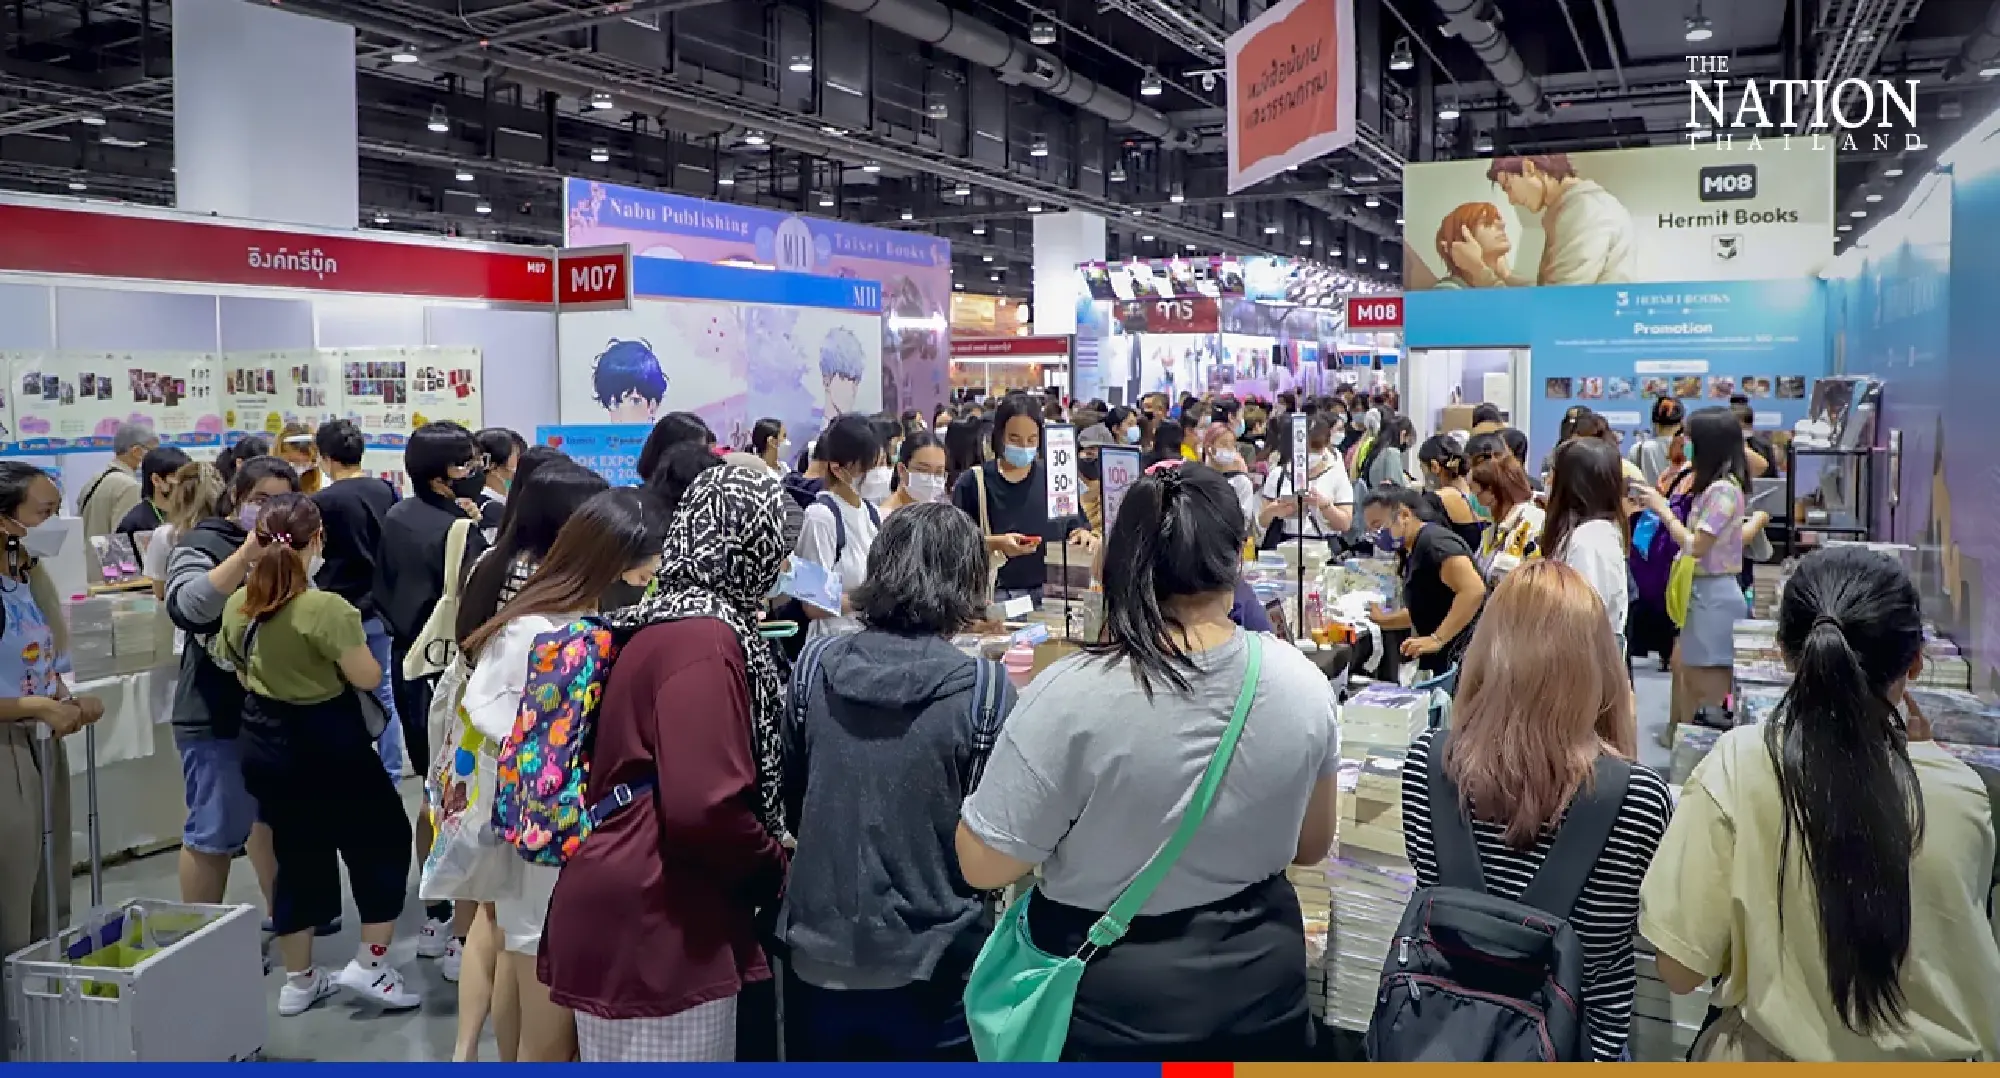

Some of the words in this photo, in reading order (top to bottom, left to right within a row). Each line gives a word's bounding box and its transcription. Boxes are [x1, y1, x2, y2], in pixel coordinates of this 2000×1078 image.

[1704, 173, 1753, 193] M08
[611, 197, 656, 221] Nabu
[662, 206, 749, 236] Publishing
[1658, 208, 1729, 228] Hermit
[1735, 207, 1798, 225] Books
[527, 261, 546, 274] M07
[571, 264, 617, 293] M07
[1357, 303, 1397, 321] M08
[1633, 321, 1713, 335] Promotion
